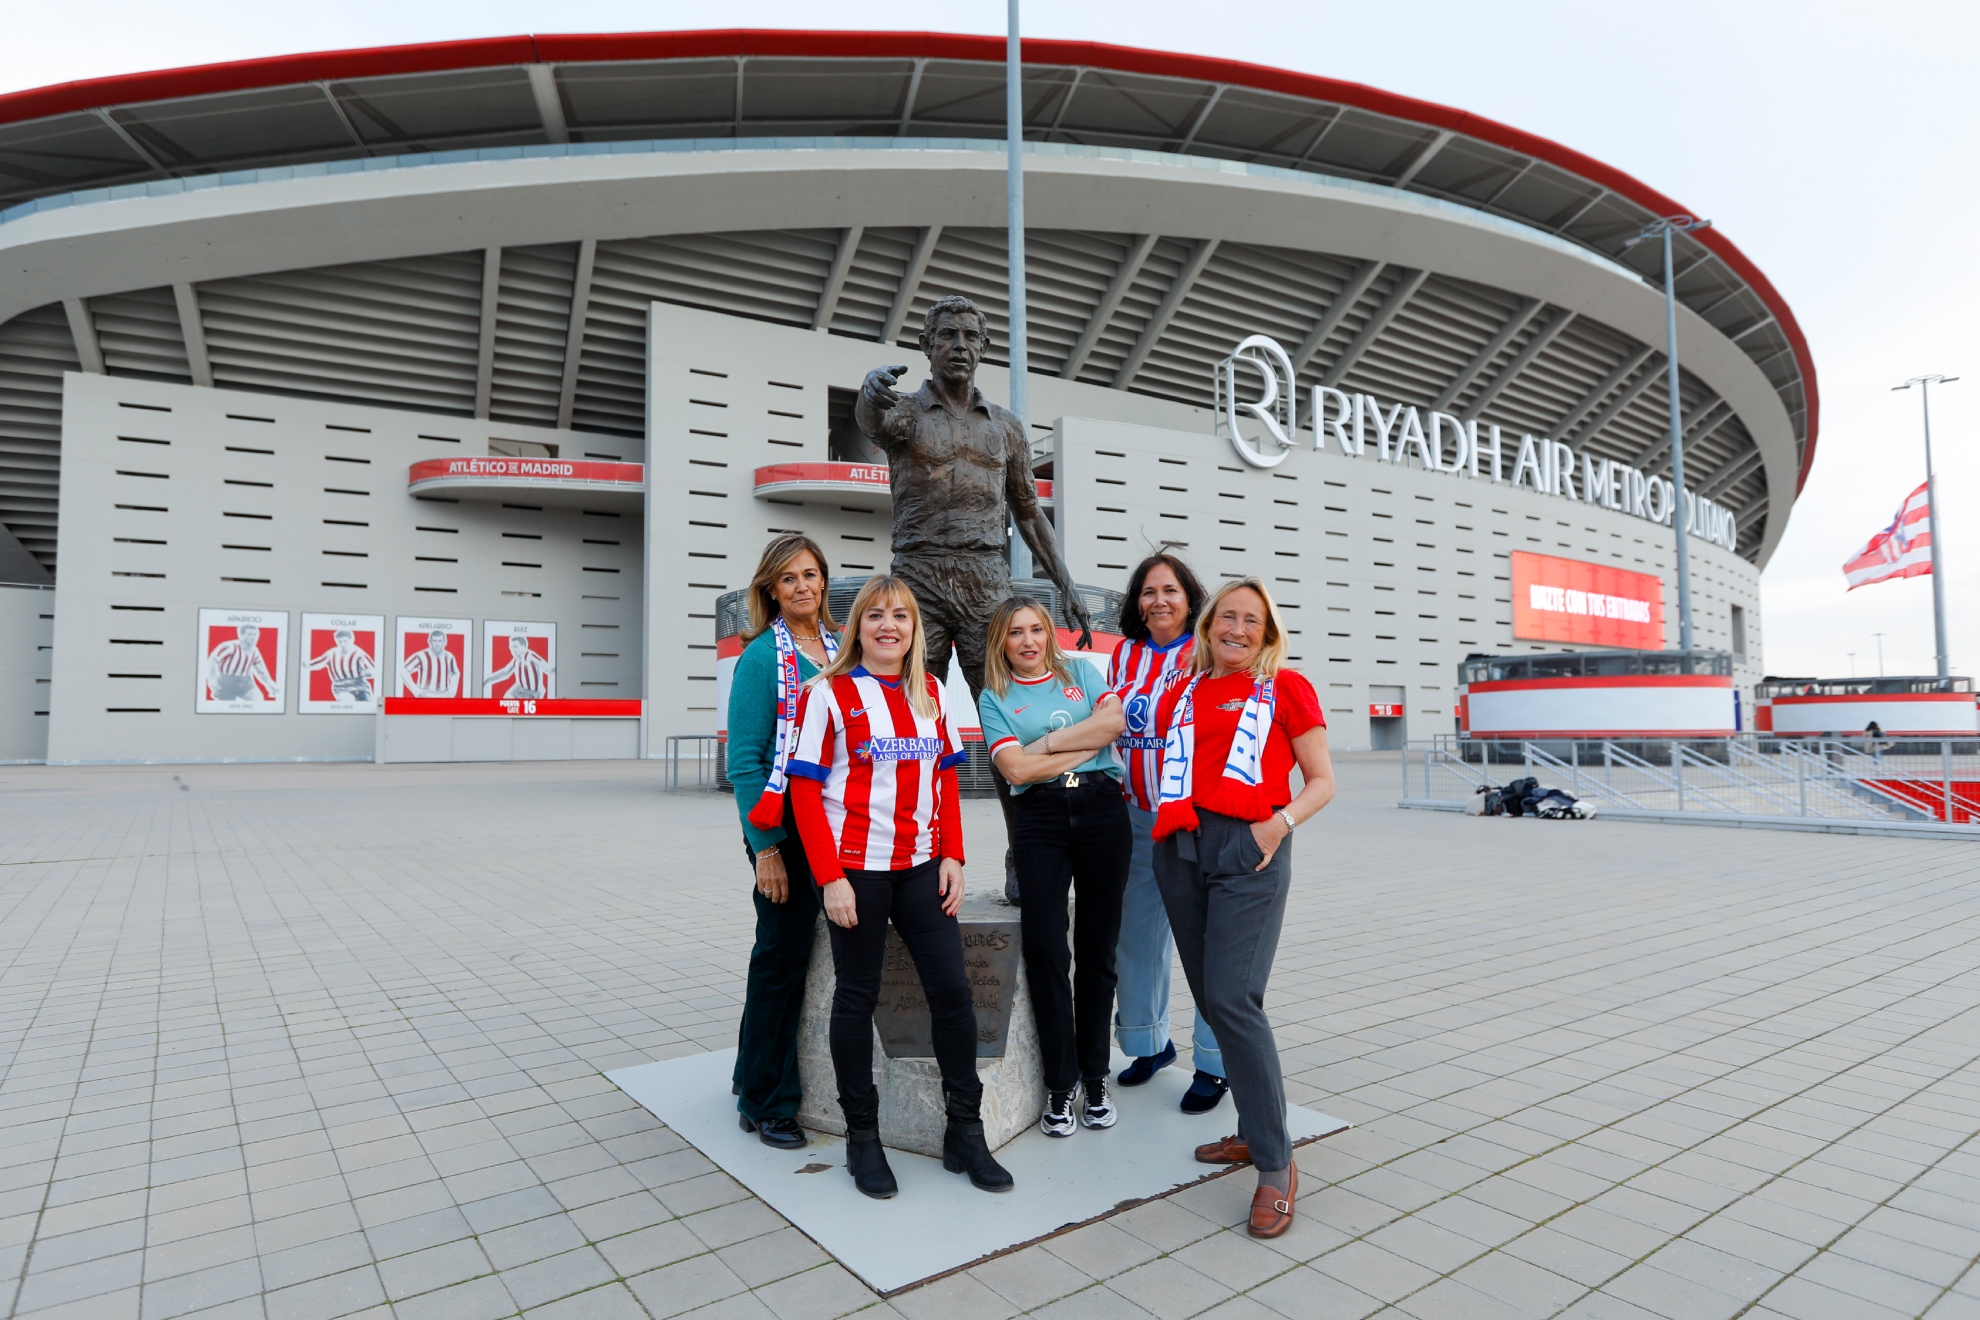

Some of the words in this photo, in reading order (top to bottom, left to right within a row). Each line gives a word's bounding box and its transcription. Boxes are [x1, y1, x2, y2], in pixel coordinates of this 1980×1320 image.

[1312, 385, 1502, 482] RIYADH
[1511, 433, 1578, 500] AIR
[449, 459, 506, 473] ATLÉTICO
[508, 462, 519, 473] DE
[521, 462, 573, 475] MADRID
[1530, 584, 1565, 612] HAZTE
[1566, 589, 1587, 615] CON
[1587, 592, 1605, 617] TUS
[418, 622, 452, 630] ADELARDO
[523, 700, 537, 714] 16
[1146, 738, 1164, 748] AIR
[873, 752, 898, 761] LAND
[900, 752, 911, 760] OF
[914, 752, 932, 760] FIRE
